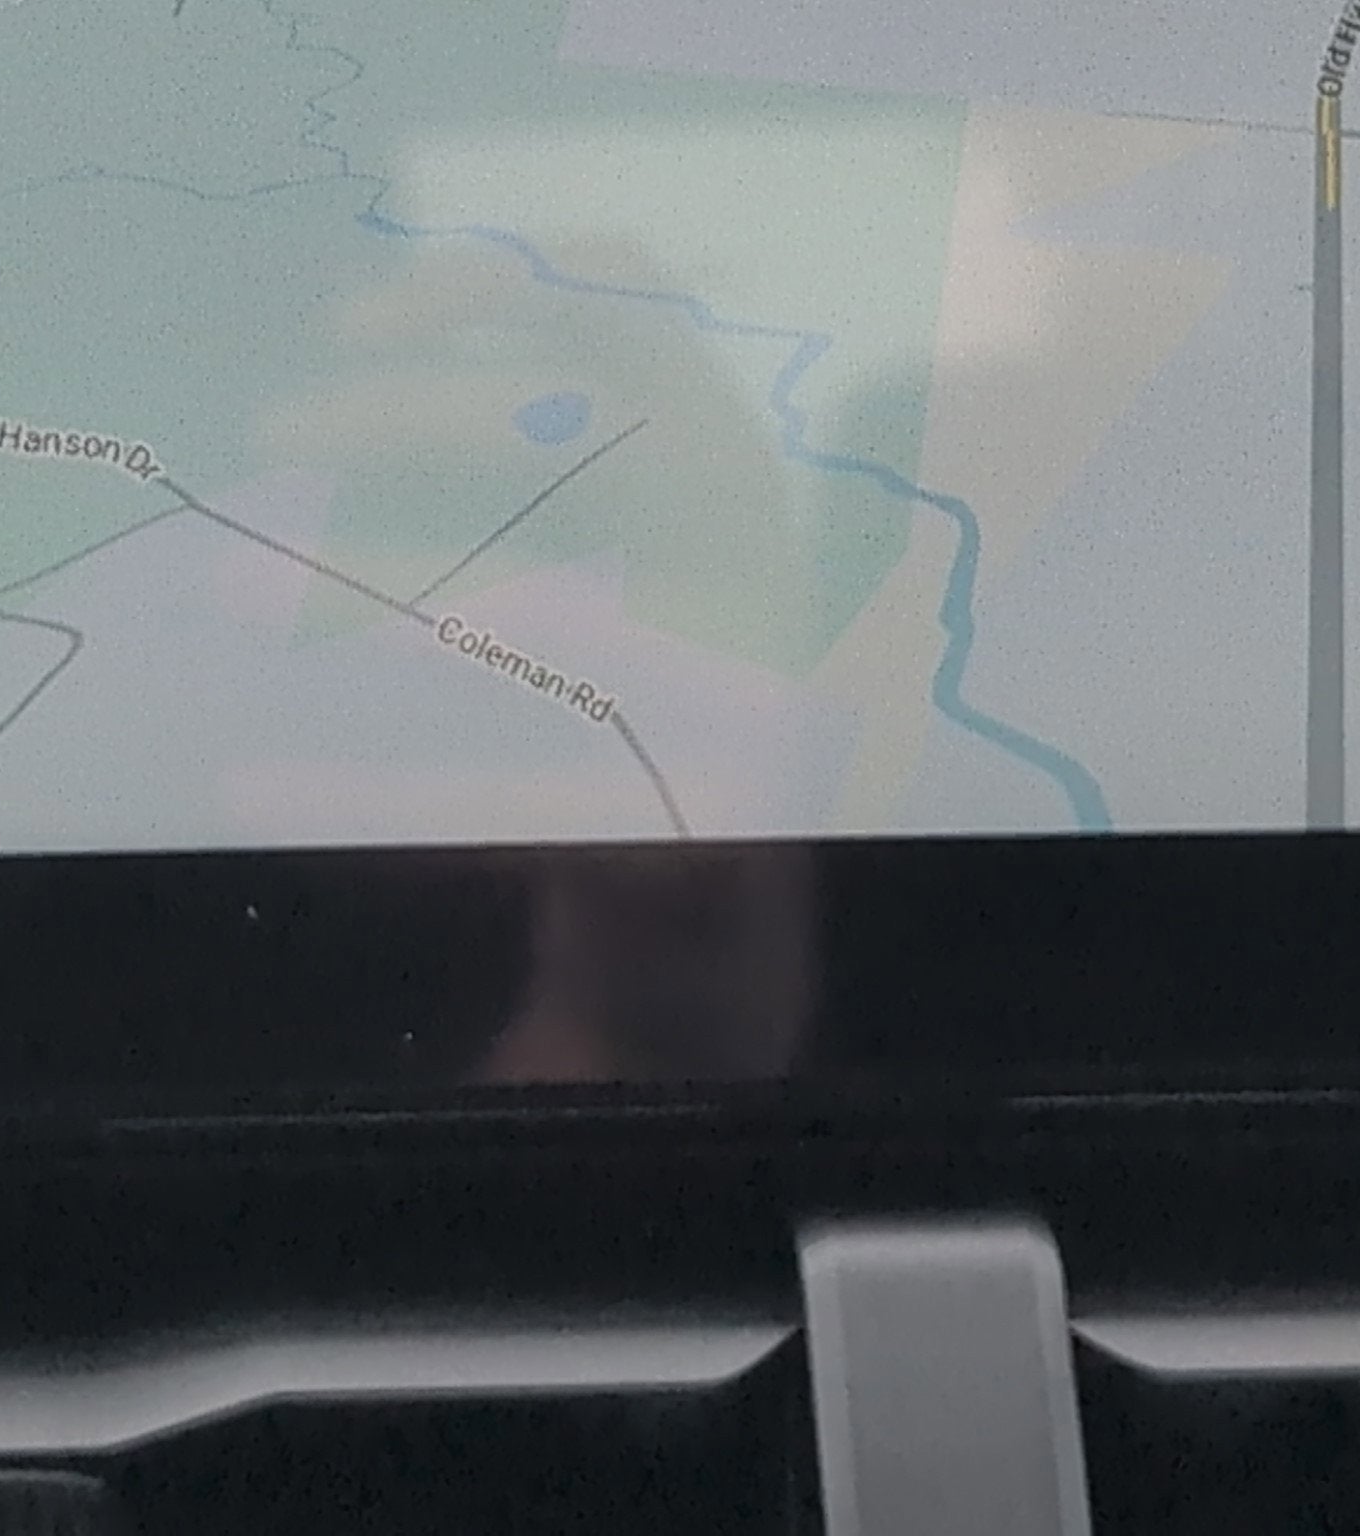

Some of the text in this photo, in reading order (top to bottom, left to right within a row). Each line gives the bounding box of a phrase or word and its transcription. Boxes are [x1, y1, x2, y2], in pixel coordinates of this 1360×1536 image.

[1315, 43, 1352, 99] Old
[123, 445, 161, 482] Dr
[437, 616, 616, 725] Coleman Rd
